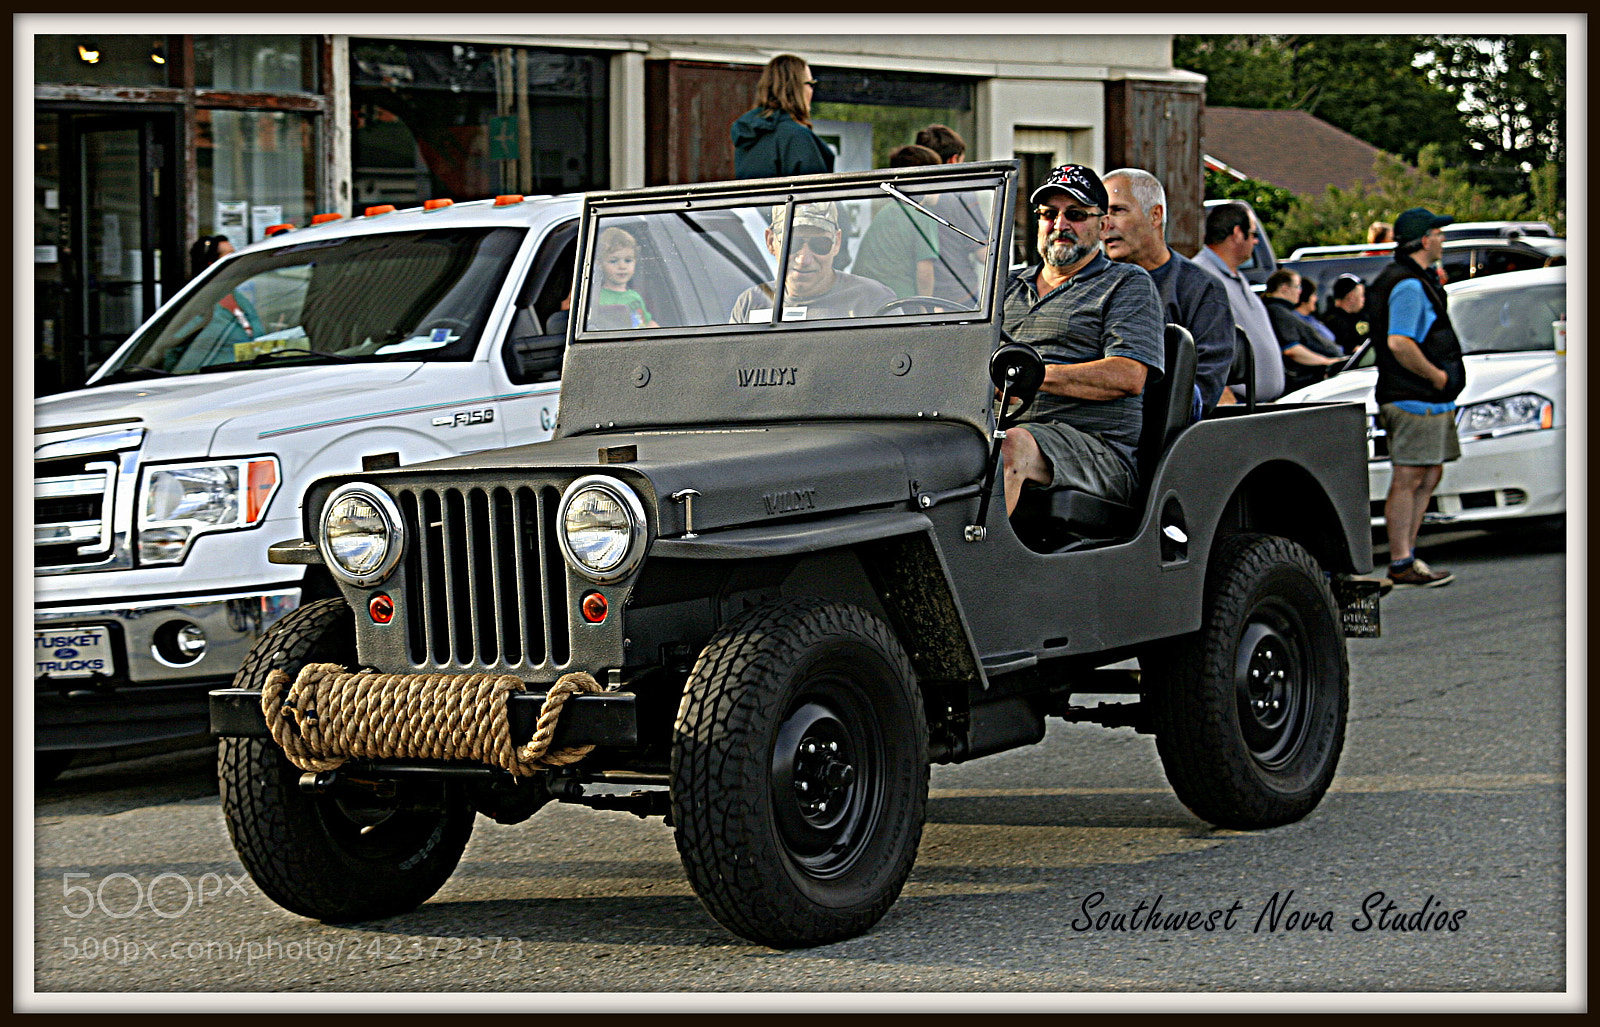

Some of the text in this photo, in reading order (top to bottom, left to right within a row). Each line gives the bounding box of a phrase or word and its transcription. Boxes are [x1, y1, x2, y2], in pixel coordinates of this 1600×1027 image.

[736, 367, 798, 387] WILLYS
[34, 634, 102, 648] TUSKET
[36, 659, 104, 671] TRUCKS
